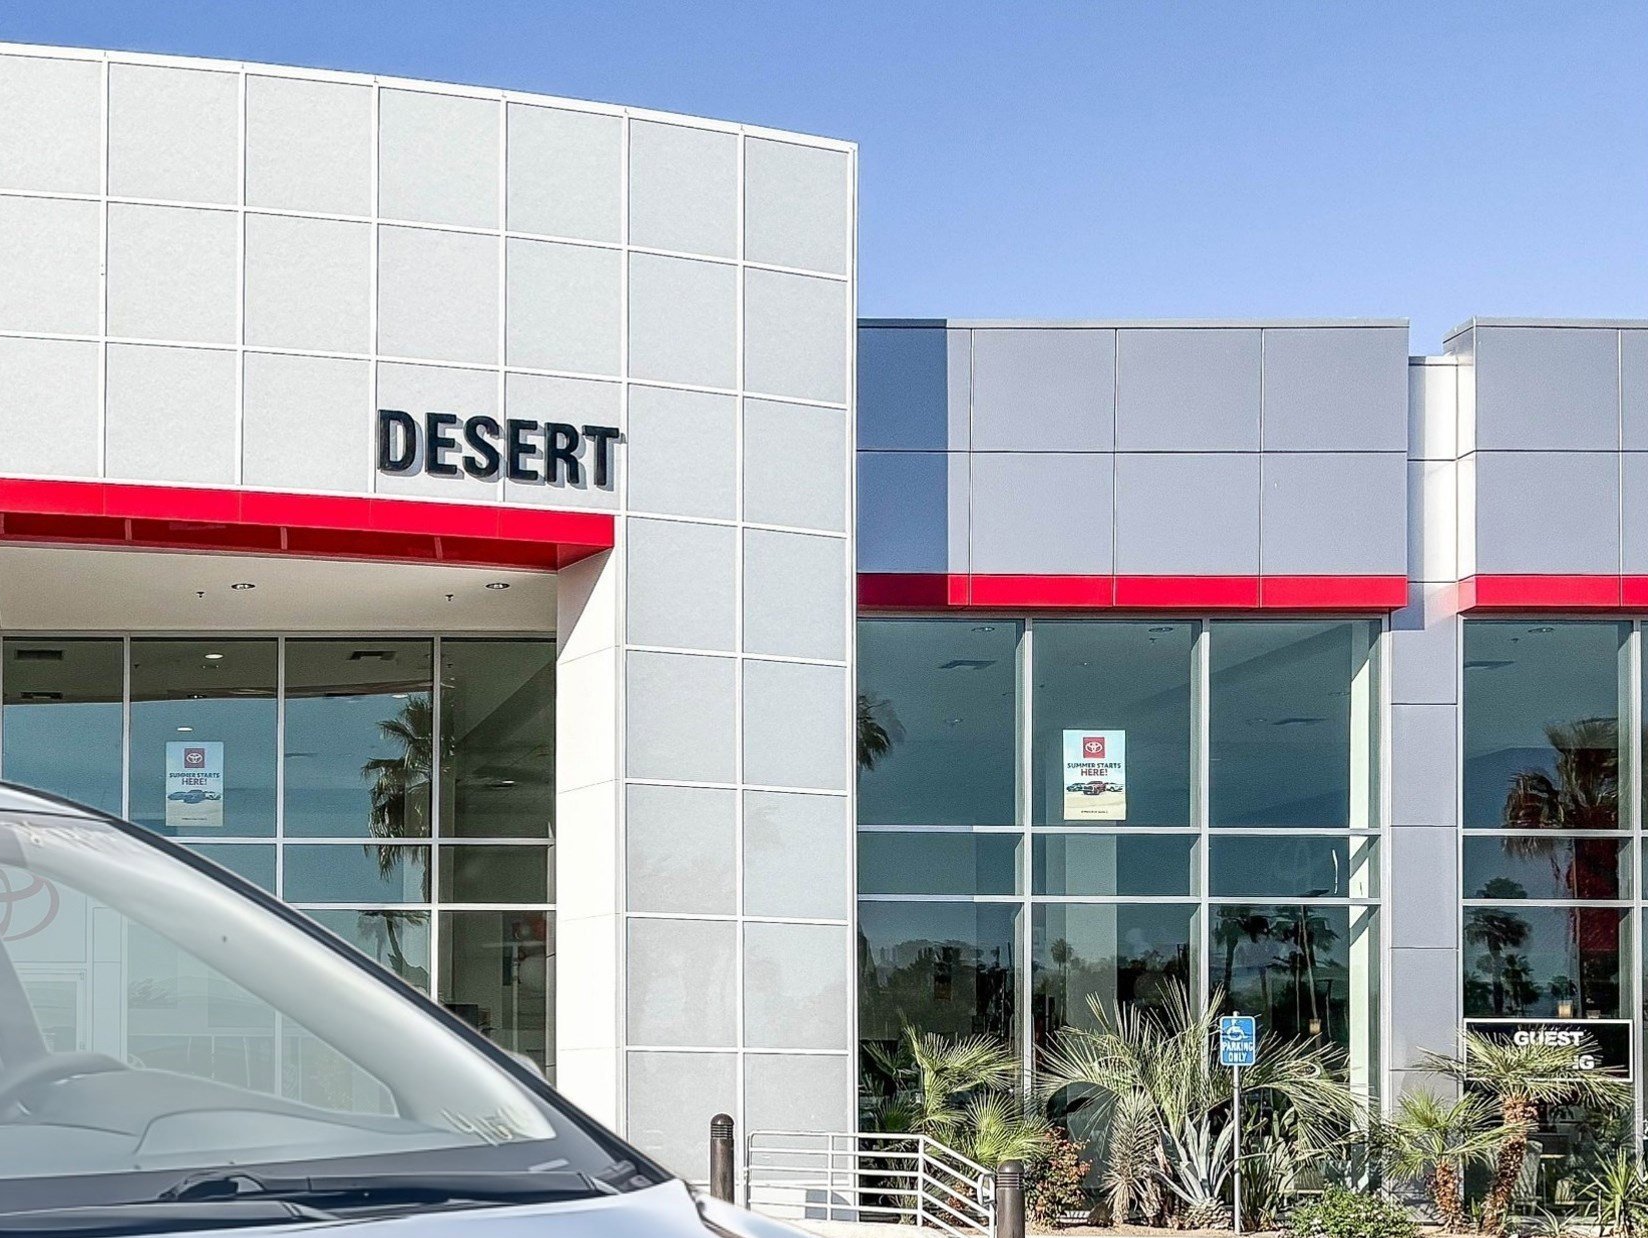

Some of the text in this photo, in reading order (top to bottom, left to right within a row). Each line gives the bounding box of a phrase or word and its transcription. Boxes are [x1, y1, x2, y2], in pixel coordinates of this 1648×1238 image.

[377, 409, 619, 486] DESERT
[1080, 768, 1108, 776] HERE!
[1514, 1031, 1584, 1046] GUEST
[1222, 1041, 1253, 1052] PARKING
[1228, 1052, 1247, 1062] ONLY
